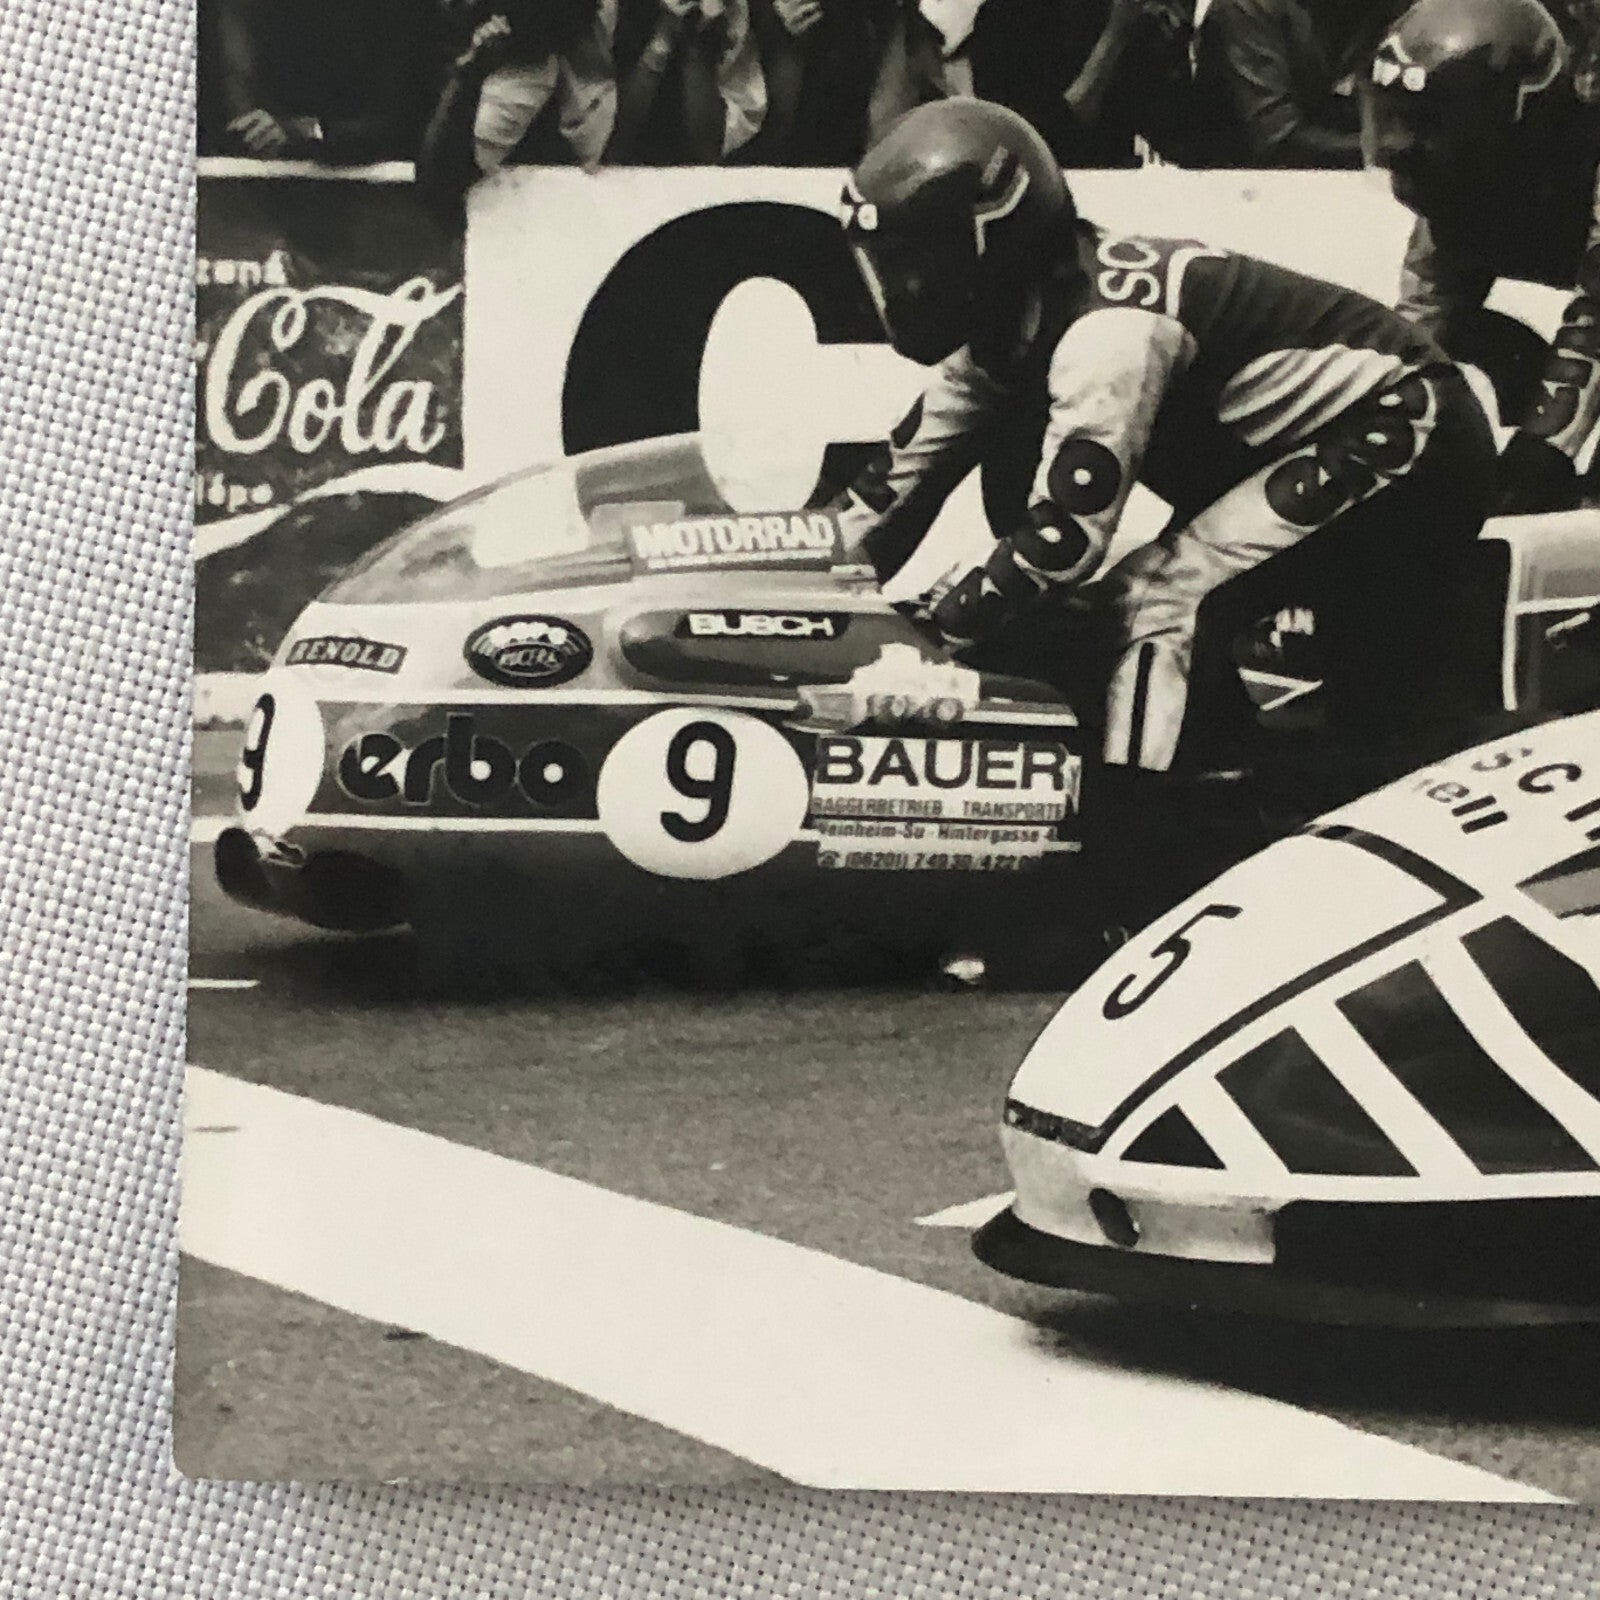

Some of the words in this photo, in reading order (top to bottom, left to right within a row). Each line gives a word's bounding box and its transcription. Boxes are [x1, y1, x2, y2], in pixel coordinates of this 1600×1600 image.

[631, 513, 836, 559] MOTORRAD
[689, 613, 835, 637] BUSCH
[337, 711, 592, 808] erbo
[660, 720, 737, 842] 9
[816, 738, 1066, 791] BAUER
[963, 801, 1064, 822] TRANSPORTE
[1103, 904, 1243, 1020] 5
